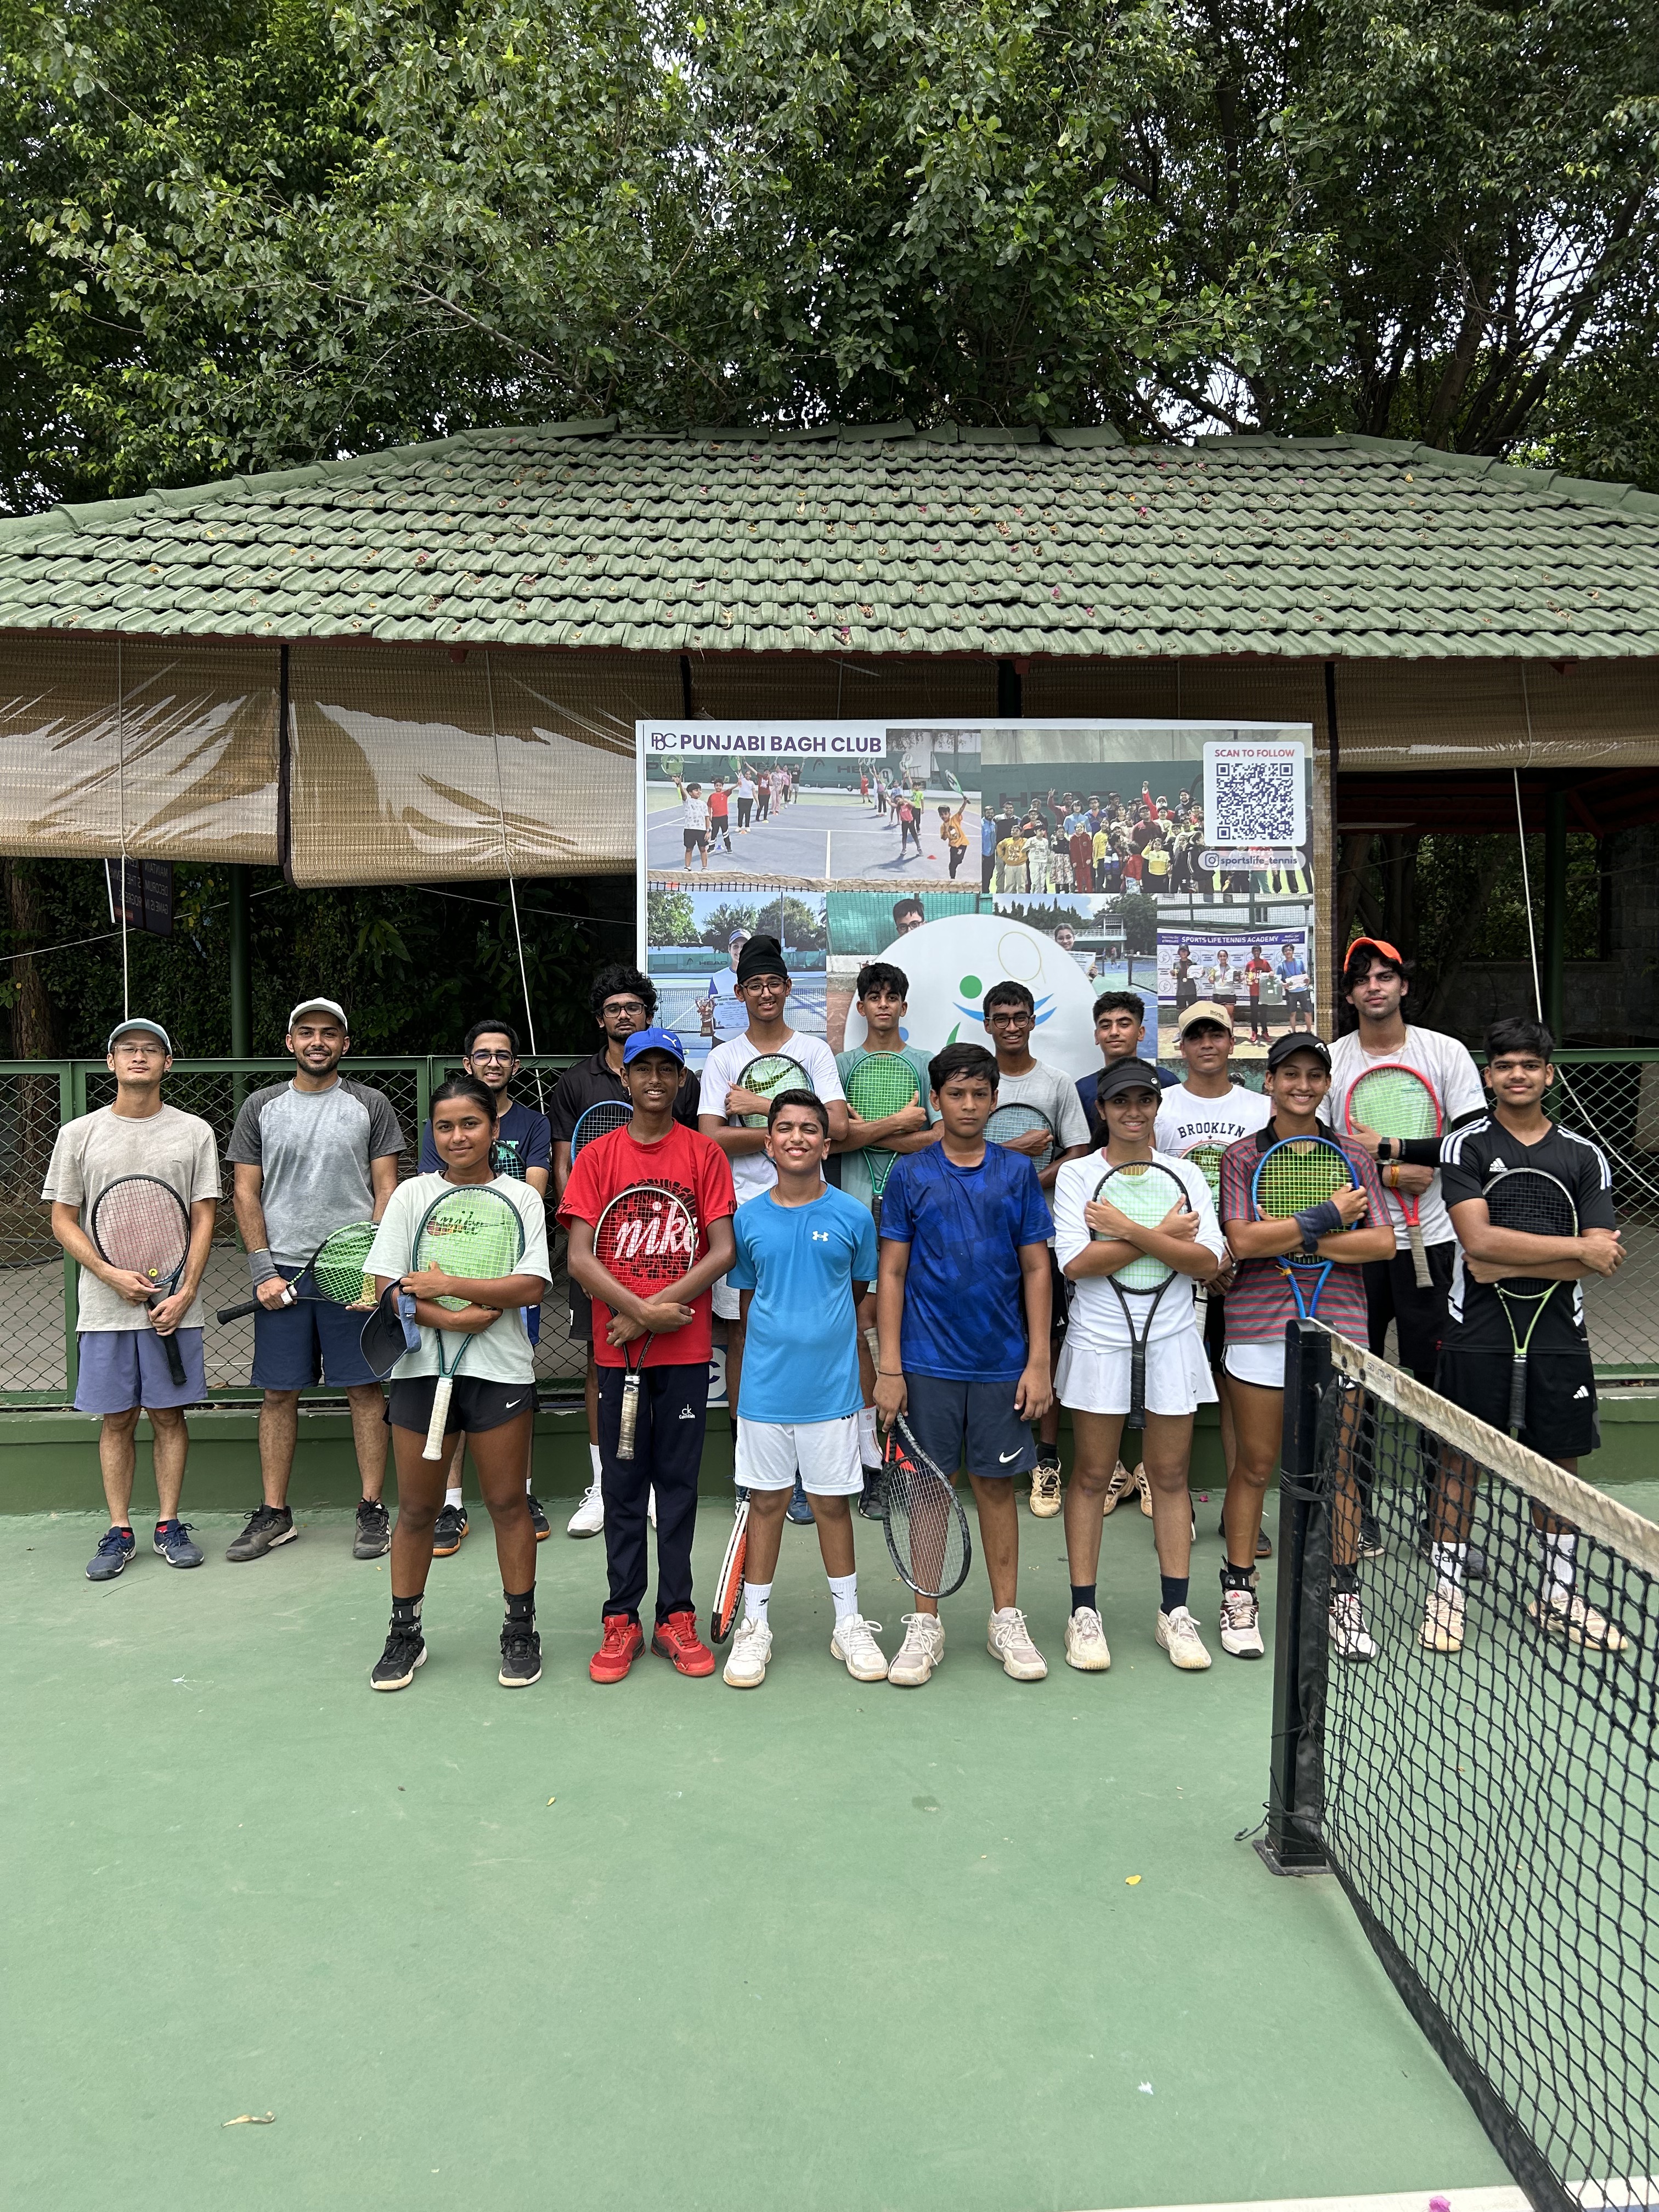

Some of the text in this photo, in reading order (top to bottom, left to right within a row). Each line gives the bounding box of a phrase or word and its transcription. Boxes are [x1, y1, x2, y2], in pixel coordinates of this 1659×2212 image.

[681, 734, 765, 751] PUNJABI
[770, 736, 826, 752] BAGH
[831, 737, 882, 752] CLUB
[1214, 749, 1239, 757] SCAN
[1256, 749, 1295, 757] FOLLOW
[1221, 856, 1297, 867] sportslife_tennis
[1177, 1122, 1245, 1139] BROOKLYN
[614, 1200, 699, 1259] nike
